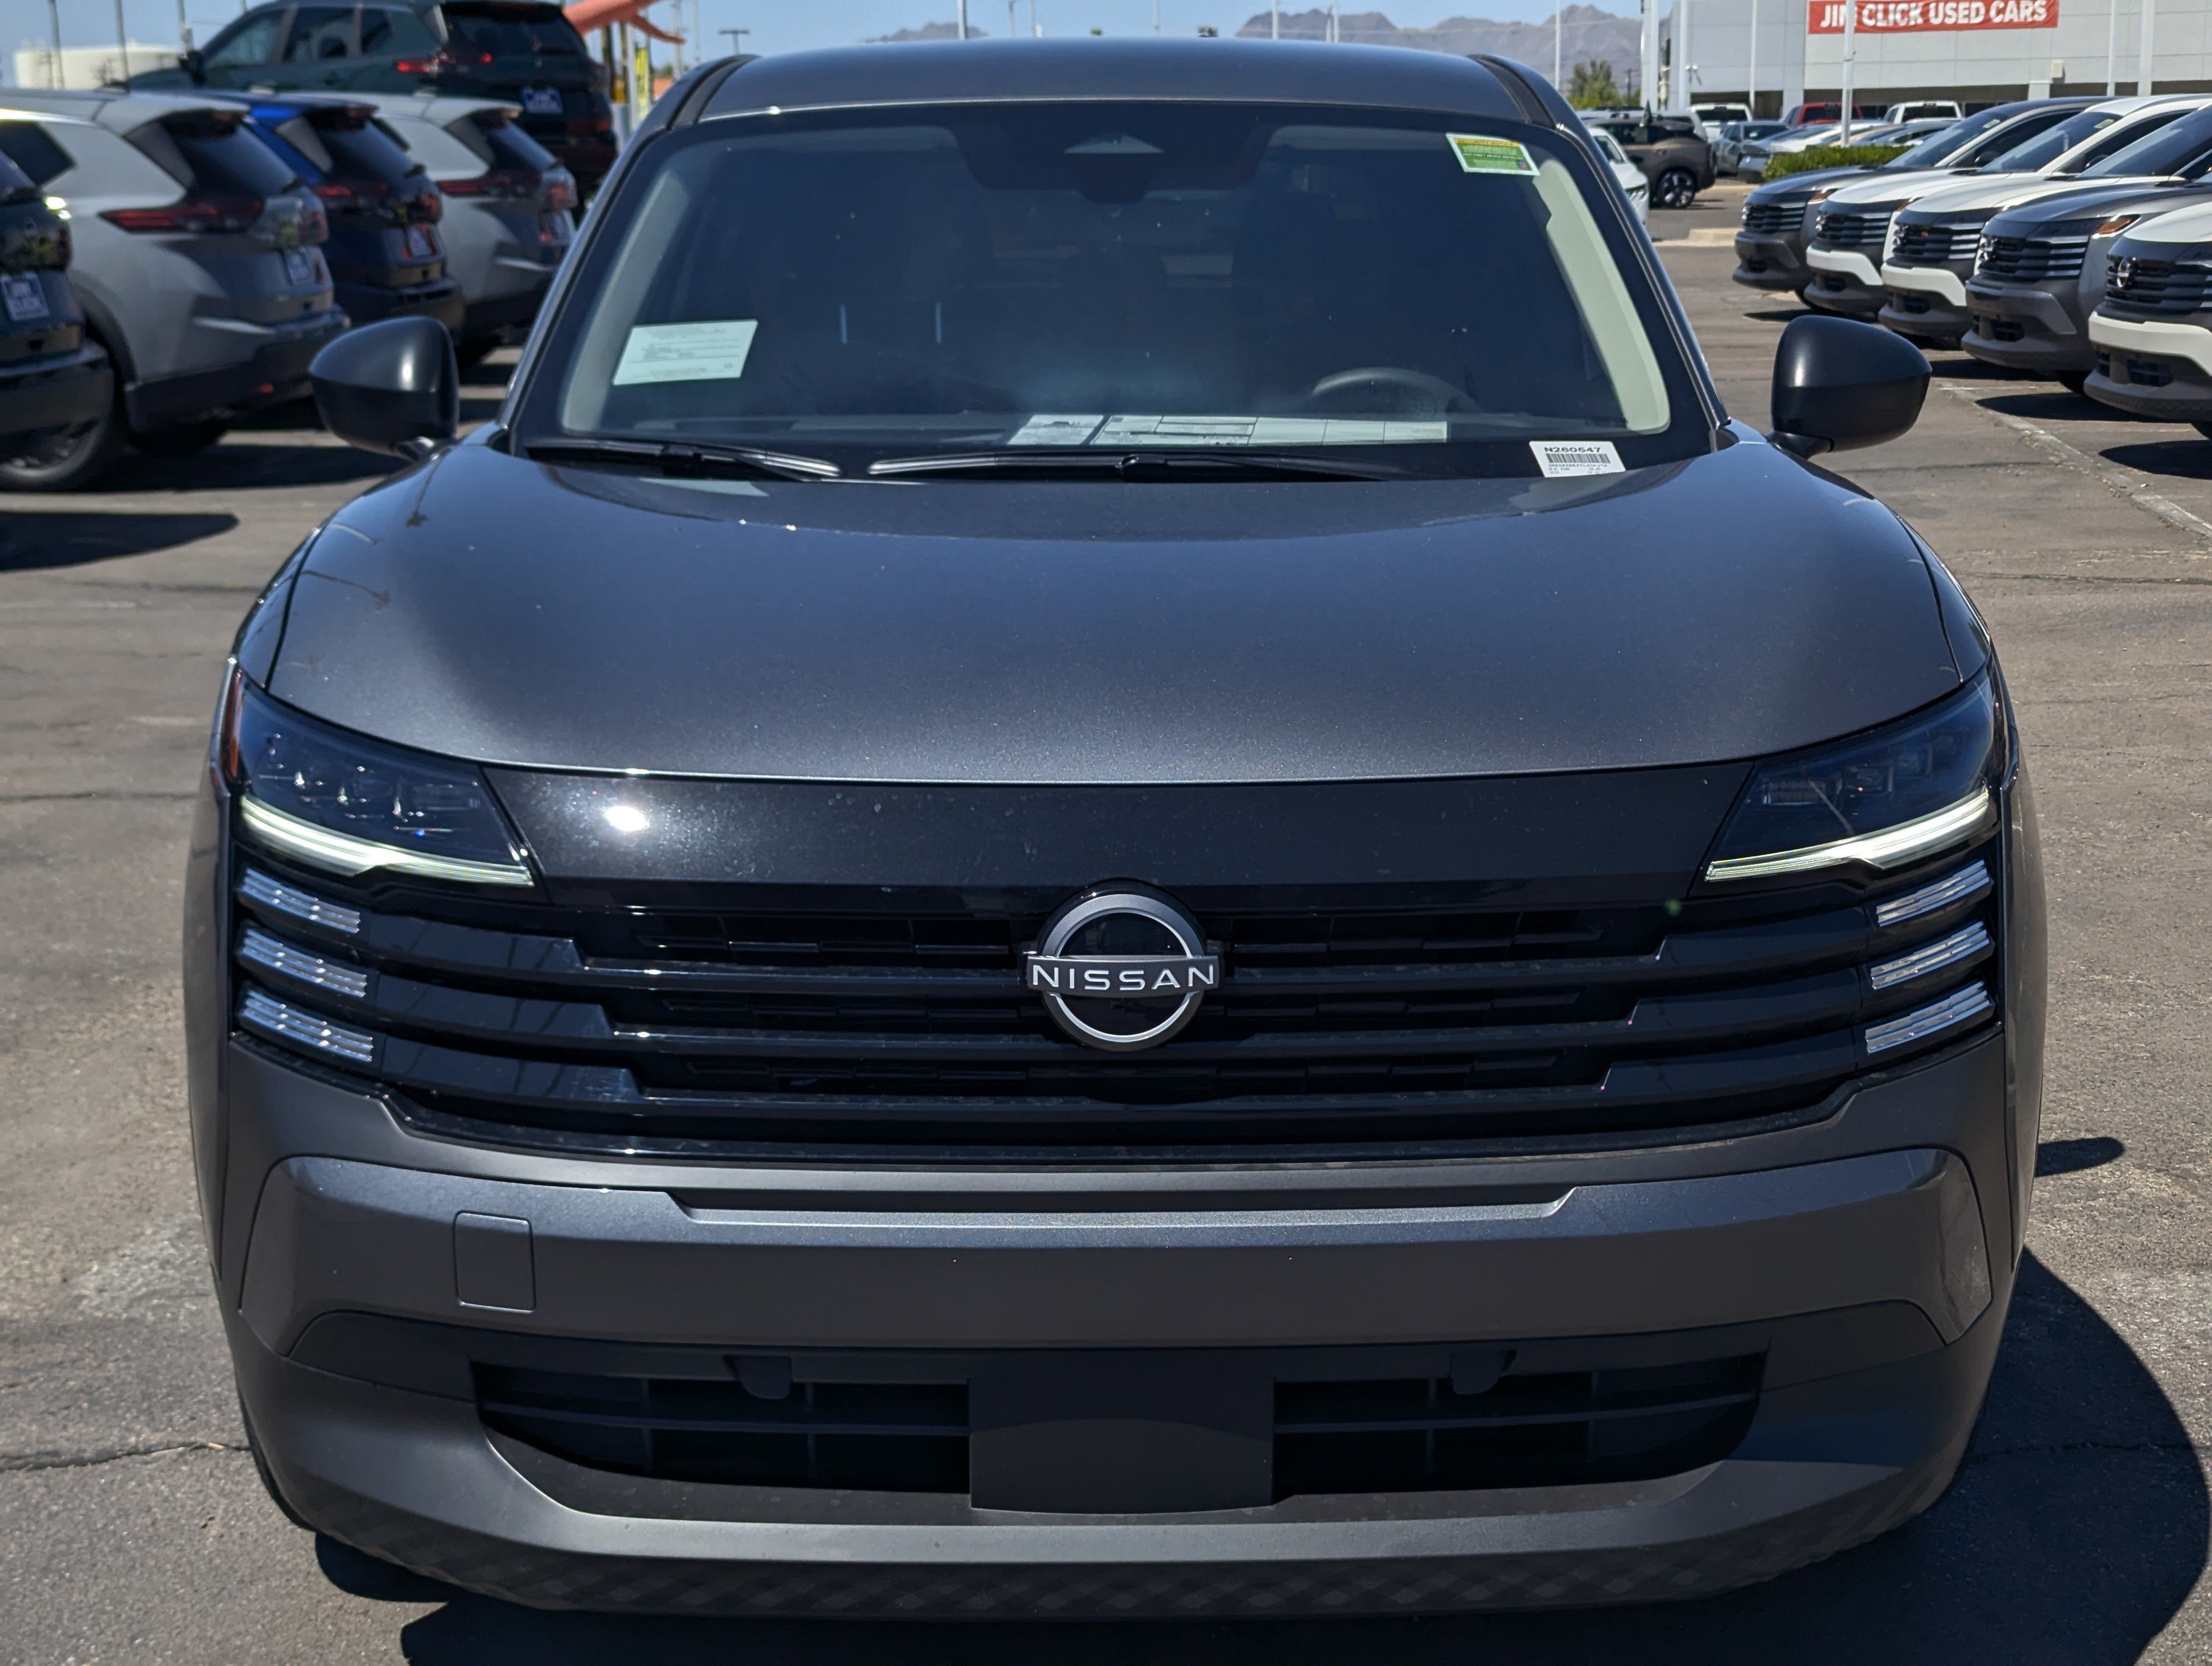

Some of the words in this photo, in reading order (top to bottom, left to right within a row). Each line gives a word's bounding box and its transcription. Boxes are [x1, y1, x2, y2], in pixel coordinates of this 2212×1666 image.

[1862, 3, 1924, 26] CLICK
[1928, 2, 1985, 24] USED
[1989, 0, 2047, 23] CARS
[1032, 964, 1214, 991] NISSAN
